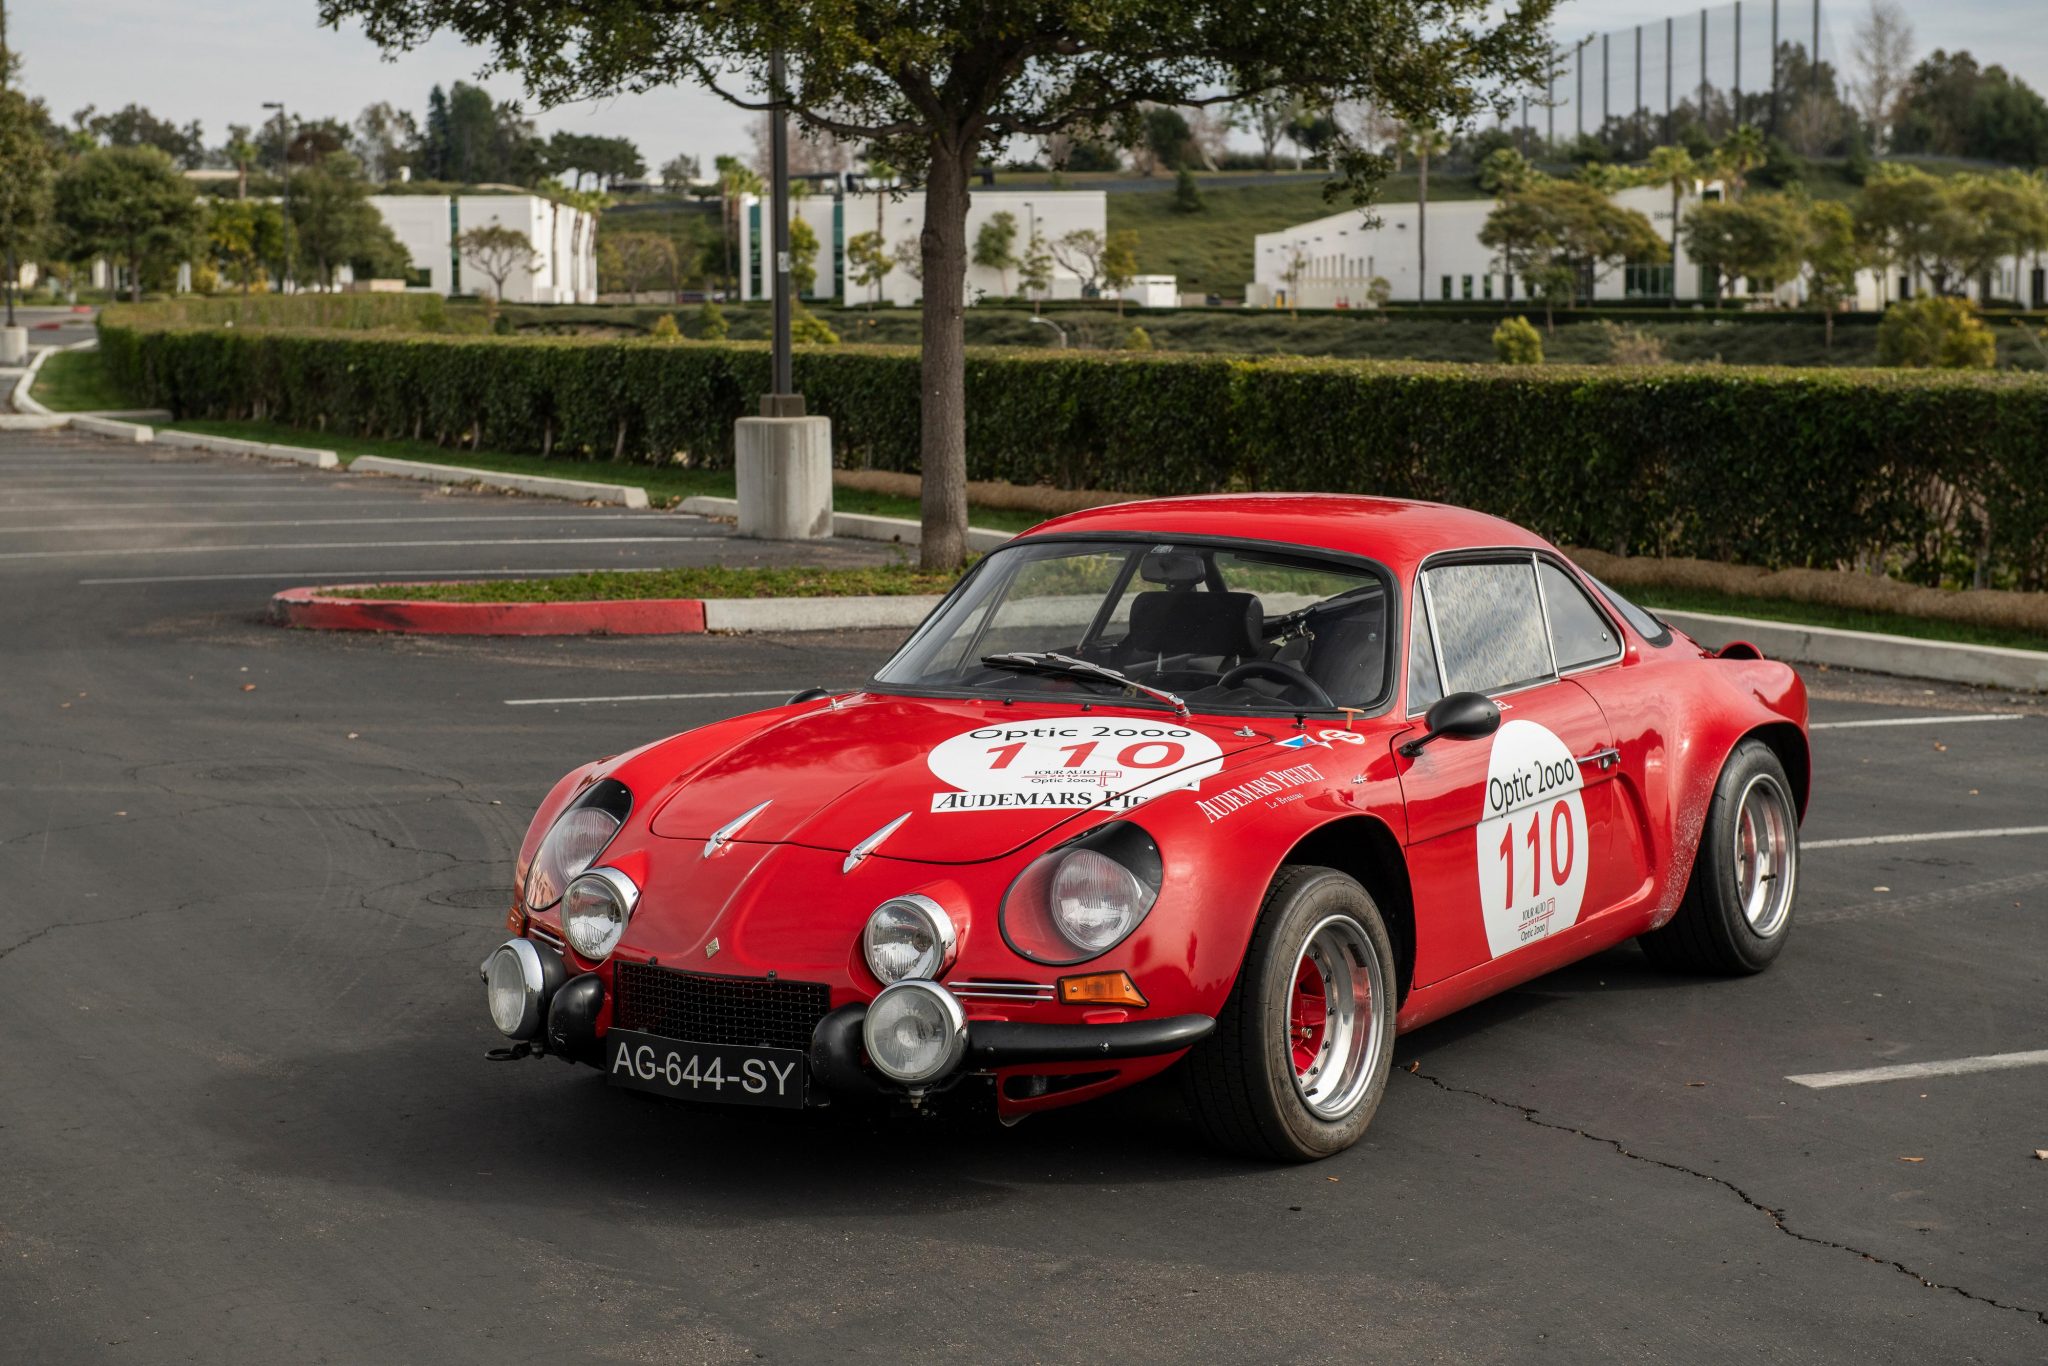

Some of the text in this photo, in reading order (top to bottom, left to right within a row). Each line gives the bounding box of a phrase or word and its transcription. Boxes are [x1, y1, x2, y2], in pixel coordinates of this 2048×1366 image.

[969, 726, 1191, 741] Optic 2000
[986, 741, 1185, 769] 110
[1195, 763, 1326, 824] AUDEMARS PIGUET
[1489, 758, 1574, 818] Optic 2000
[936, 792, 1092, 809] AUDEMARS
[1265, 801, 1278, 809] Le
[1499, 799, 1574, 910] 110
[1522, 901, 1547, 921] TOUR AUTO
[1520, 924, 1546, 942] Optic 2000
[612, 1041, 796, 1095] AG-644-SY
